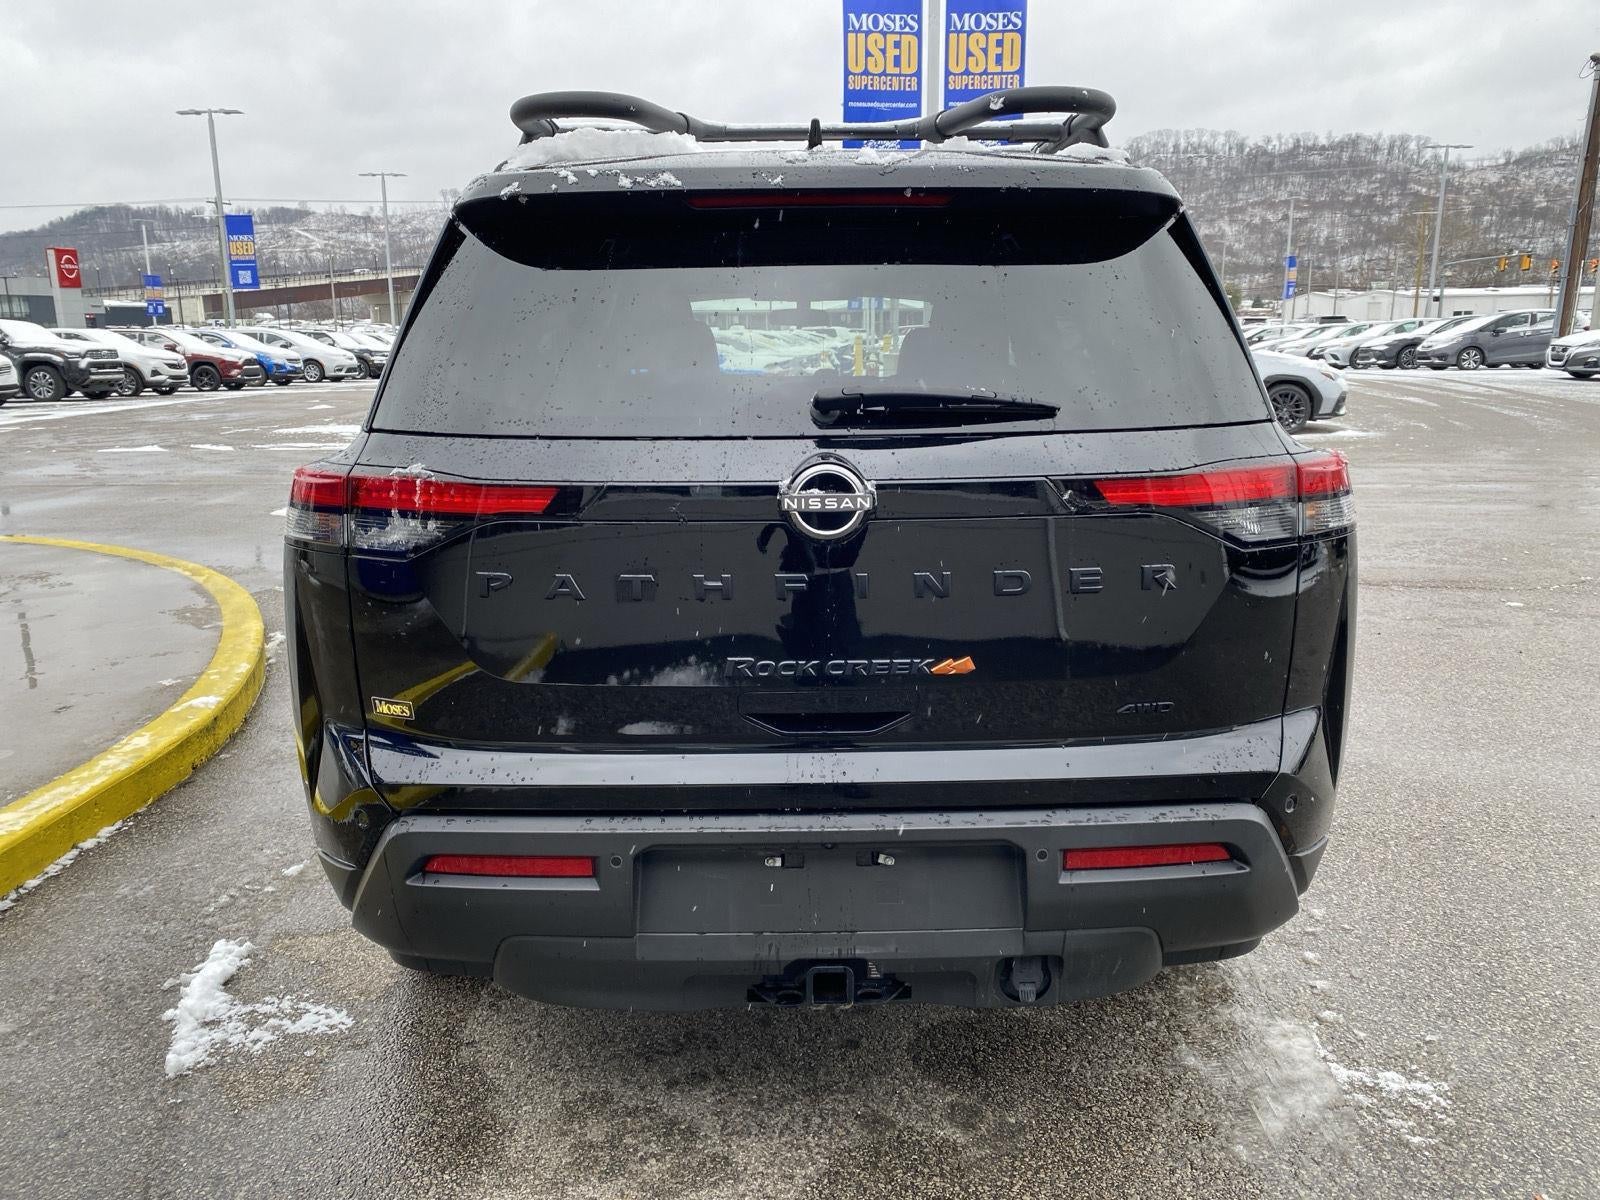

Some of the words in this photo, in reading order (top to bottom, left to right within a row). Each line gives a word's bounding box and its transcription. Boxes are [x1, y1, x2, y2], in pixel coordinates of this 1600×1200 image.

[848, 13, 919, 32] MOSES
[950, 12, 1022, 31] MOSES
[848, 33, 919, 74] USED
[949, 32, 1022, 73] USED
[848, 75, 918, 91] SUPERCENTER
[948, 74, 1020, 89] SUPERCENTER
[229, 241, 255, 255] USED
[784, 498, 870, 509] NISSAN
[475, 564, 1177, 602] PATHFINDER
[724, 657, 820, 677] ROCK
[825, 658, 935, 676] CREEK
[375, 700, 411, 717] MOSES
[1116, 701, 1175, 713] 4WD
